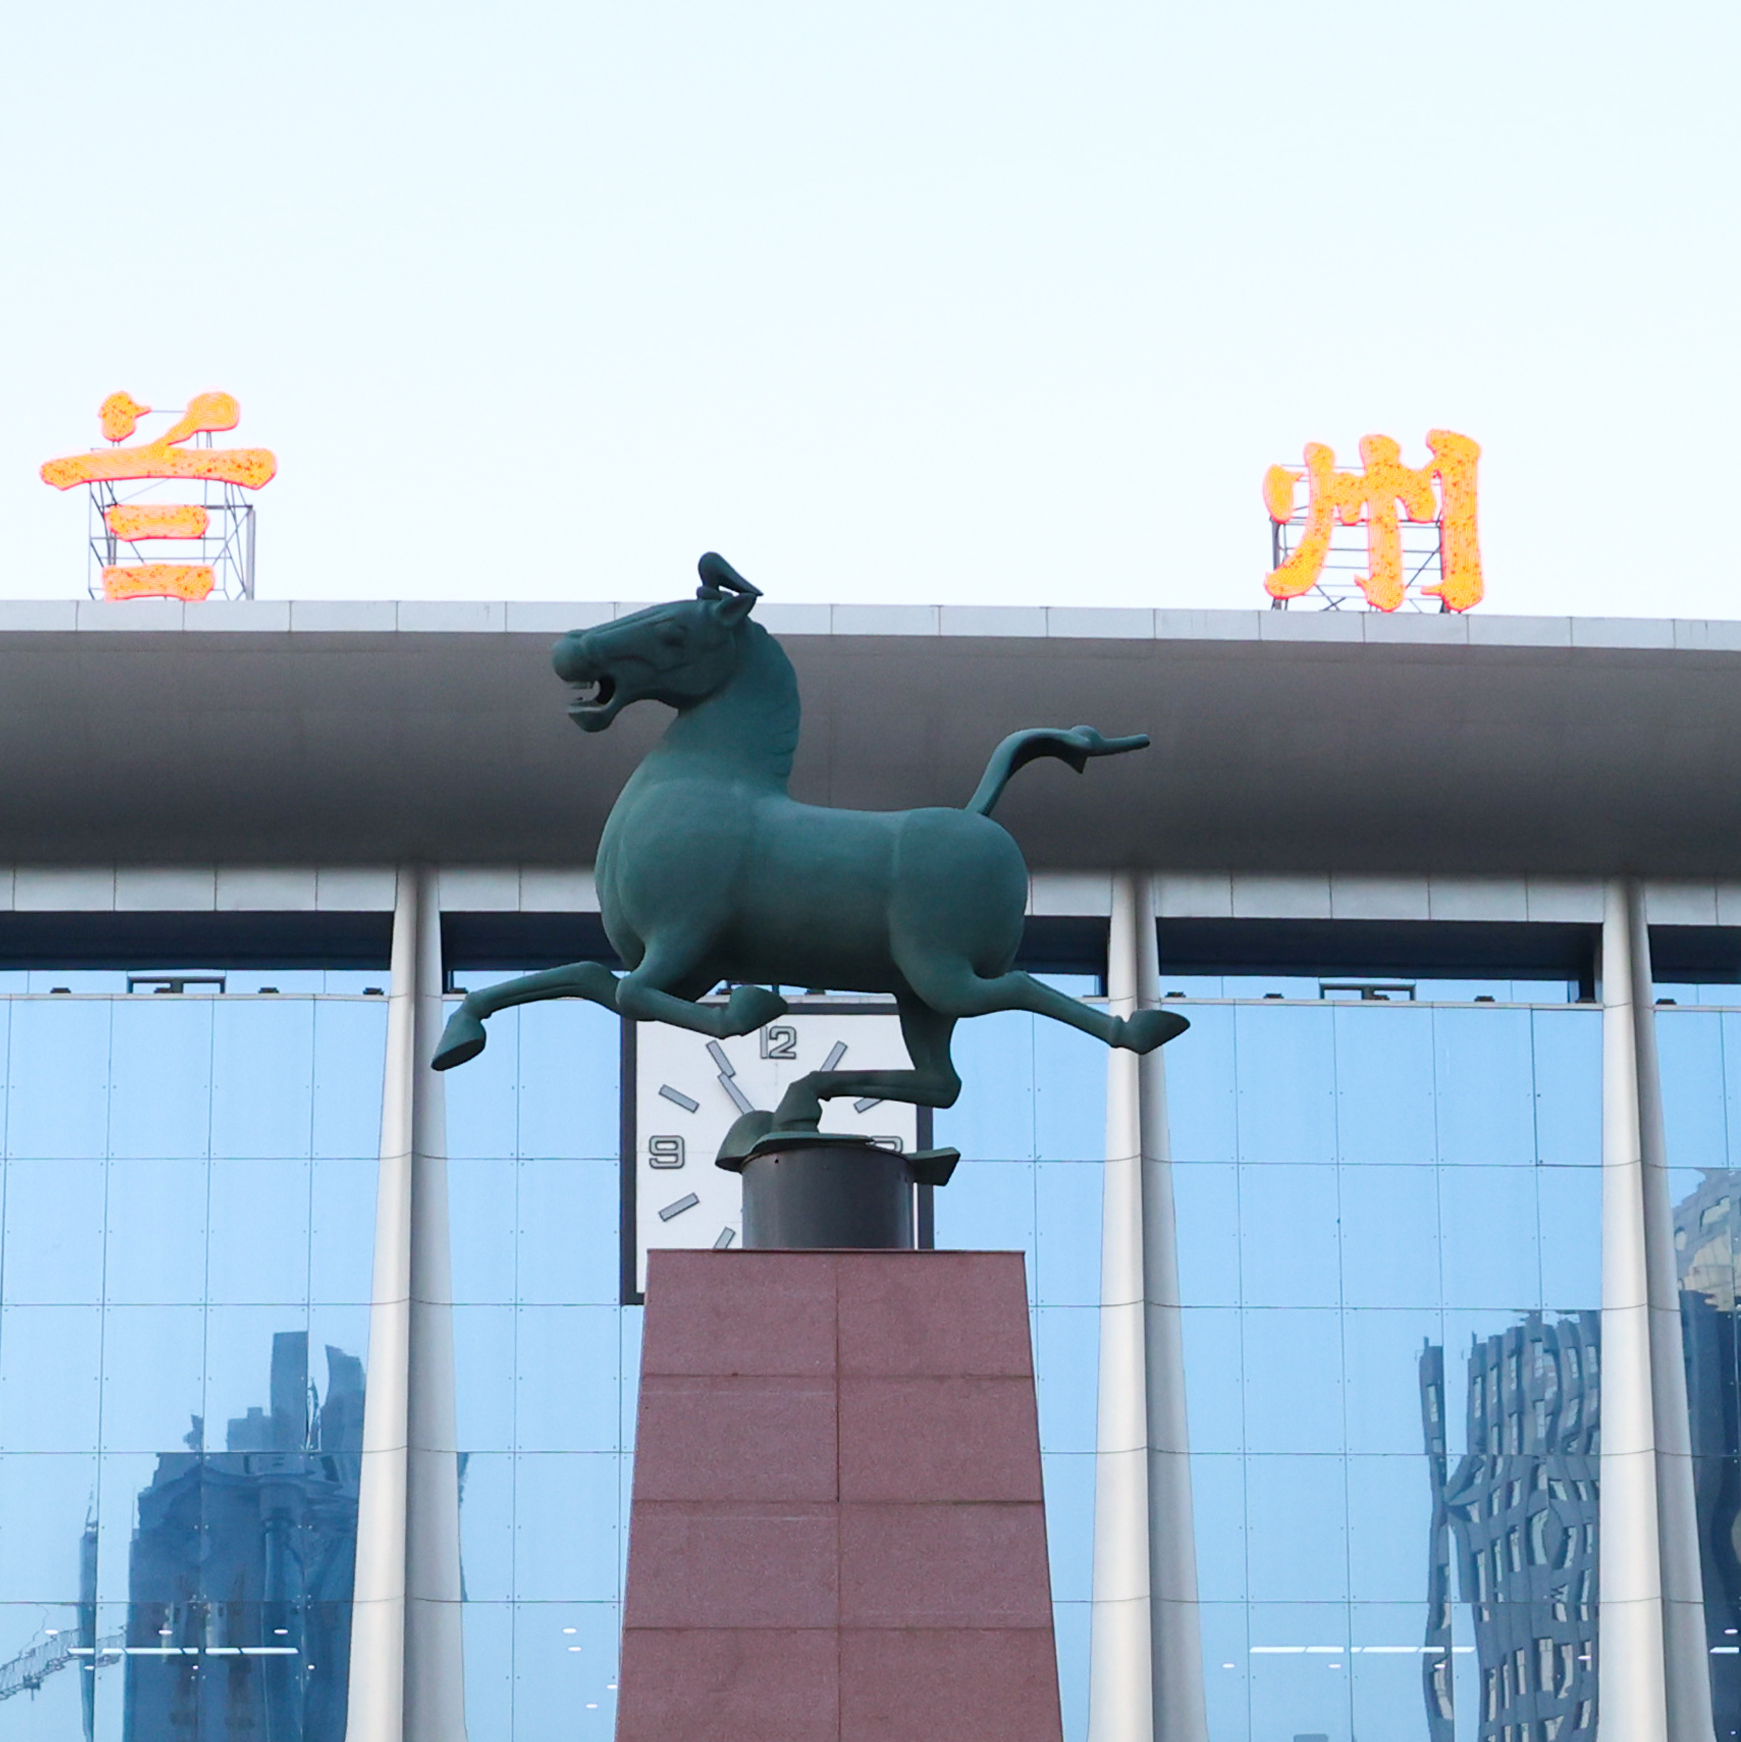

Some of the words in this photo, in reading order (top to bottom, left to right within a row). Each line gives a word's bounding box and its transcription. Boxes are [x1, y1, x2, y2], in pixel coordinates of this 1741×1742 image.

[40, 391, 276, 602] 兰
[1264, 429, 1484, 613] 州
[759, 1024, 797, 1060] 12
[649, 1135, 685, 1169] 9
